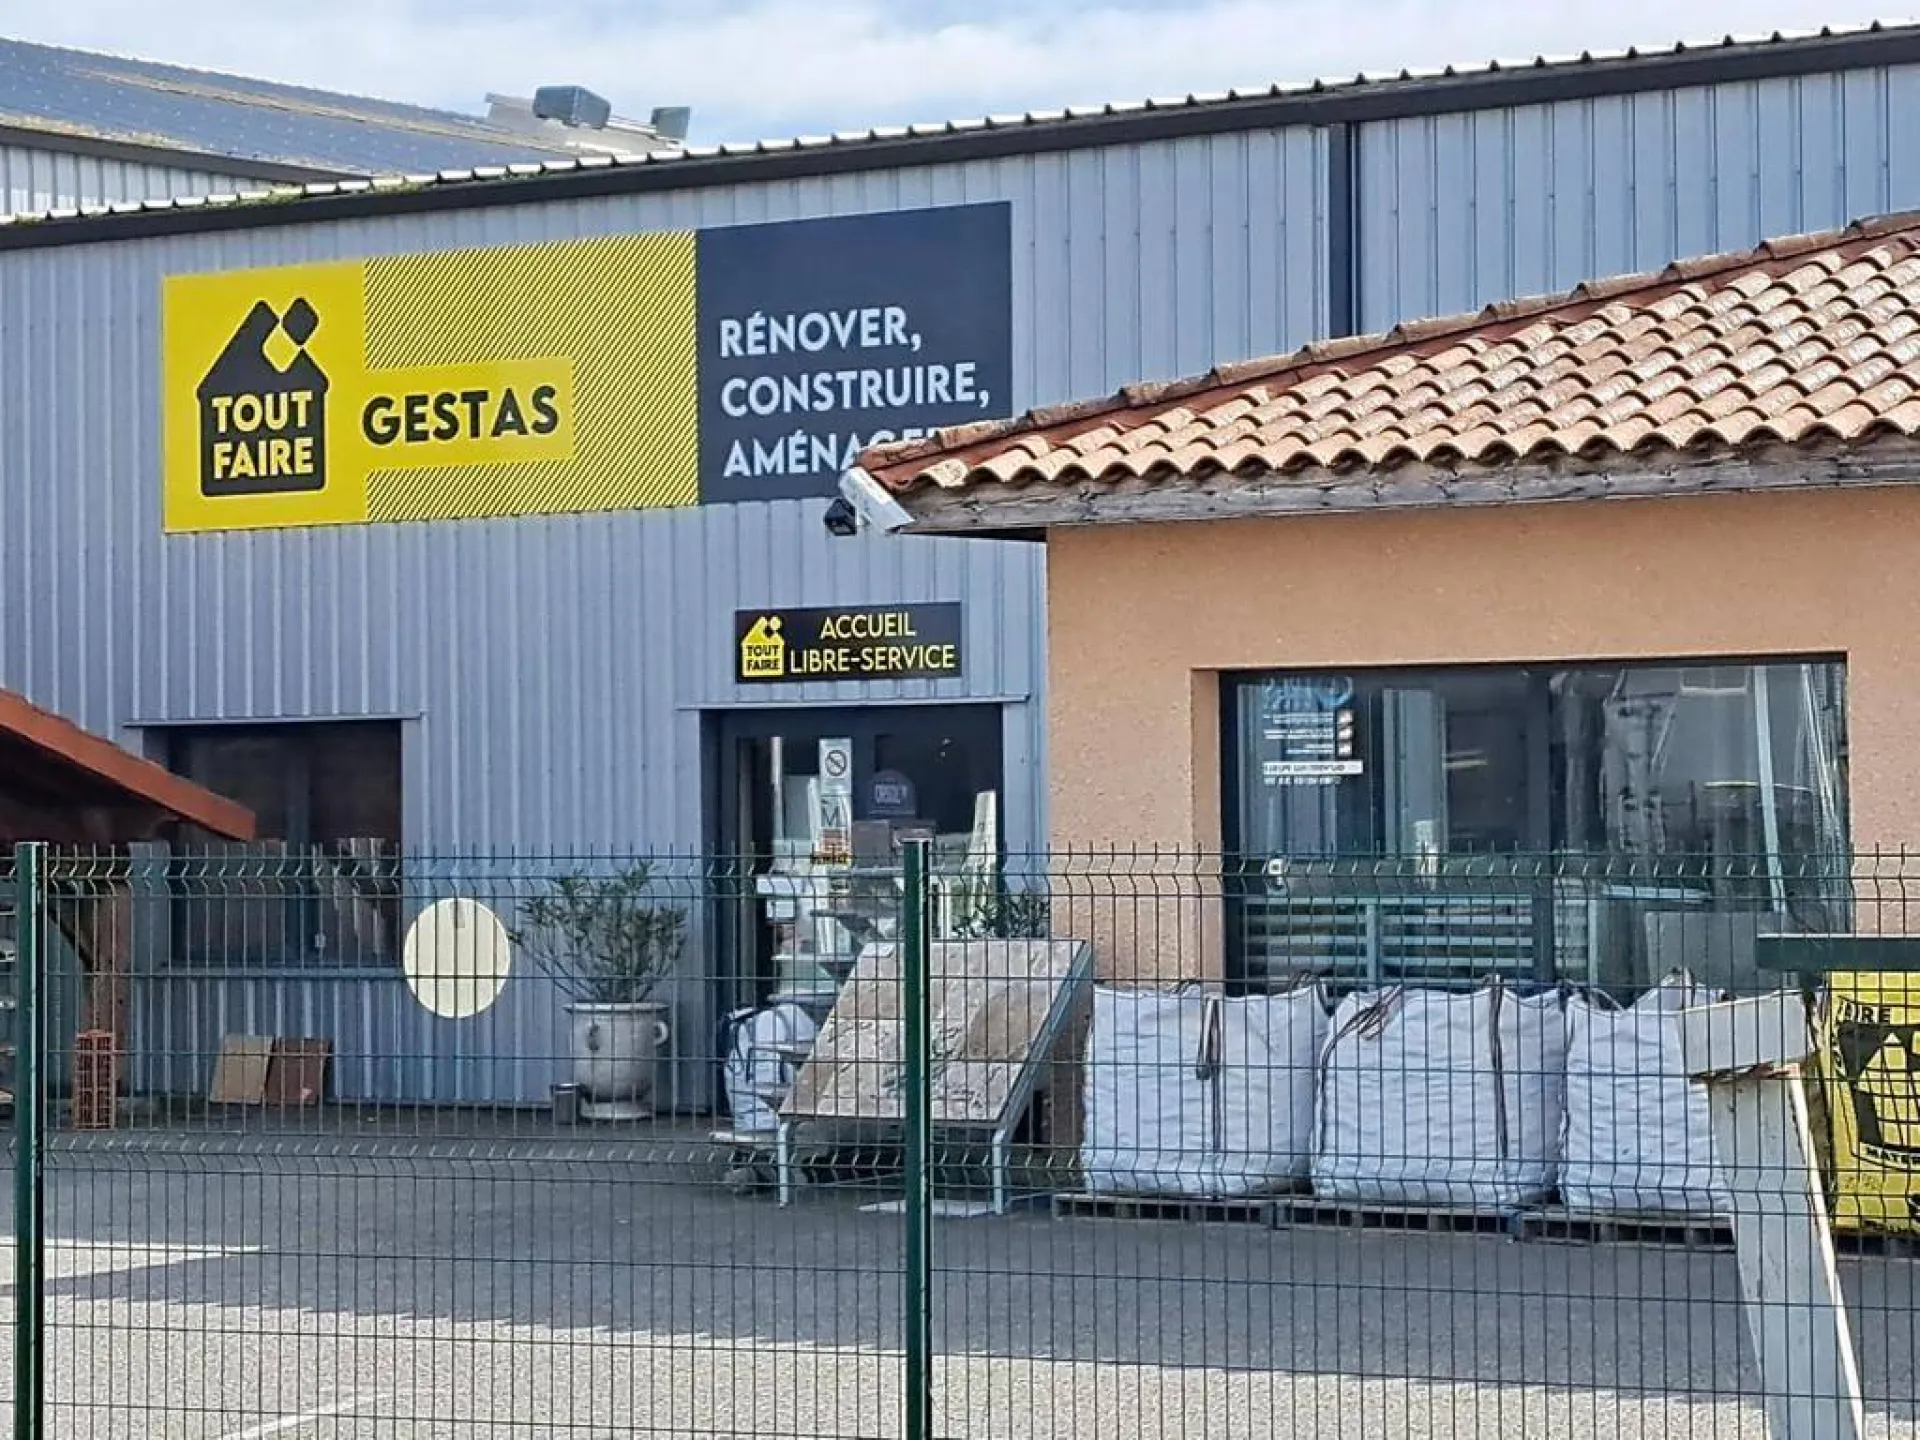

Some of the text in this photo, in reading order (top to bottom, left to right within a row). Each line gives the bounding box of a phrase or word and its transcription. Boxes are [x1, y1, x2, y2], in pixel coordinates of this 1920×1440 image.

[720, 306, 922, 357] RÉNOVER,
[721, 362, 990, 418] CONSTRUIRE,
[212, 390, 313, 434] TOUT
[362, 385, 559, 445] GESTAS
[213, 437, 314, 479] FAIRE
[723, 426, 941, 477] AMÉNA
[820, 612, 917, 640] ACCUEIL
[746, 644, 779, 657] TOUT
[746, 658, 780, 670] FAIRE
[790, 644, 956, 674] LIBRE-SERVICE
